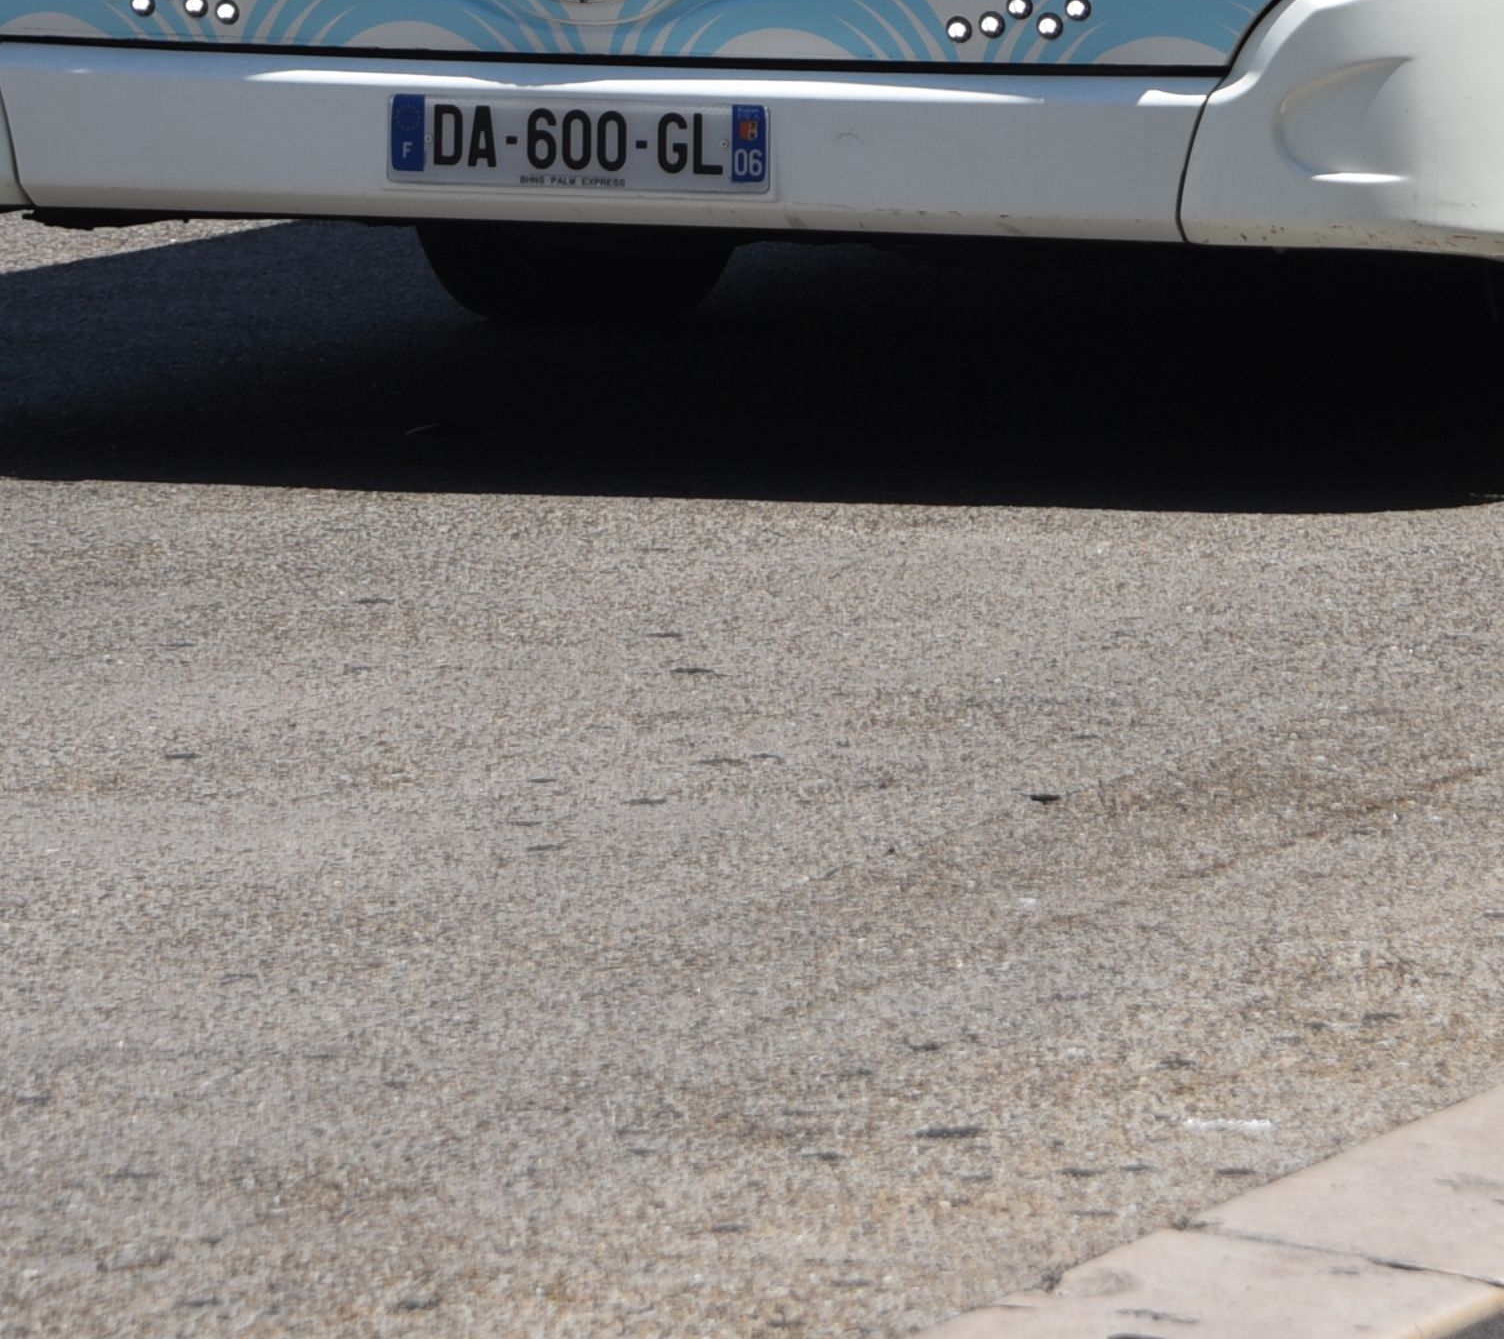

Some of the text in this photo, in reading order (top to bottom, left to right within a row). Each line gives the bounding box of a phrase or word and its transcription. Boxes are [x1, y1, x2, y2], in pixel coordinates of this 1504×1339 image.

[401, 141, 413, 160] F
[432, 103, 725, 176] DA-600-GL
[733, 147, 764, 177] 06
[550, 176, 577, 187] PALM
[581, 177, 627, 189] EXPRESS
